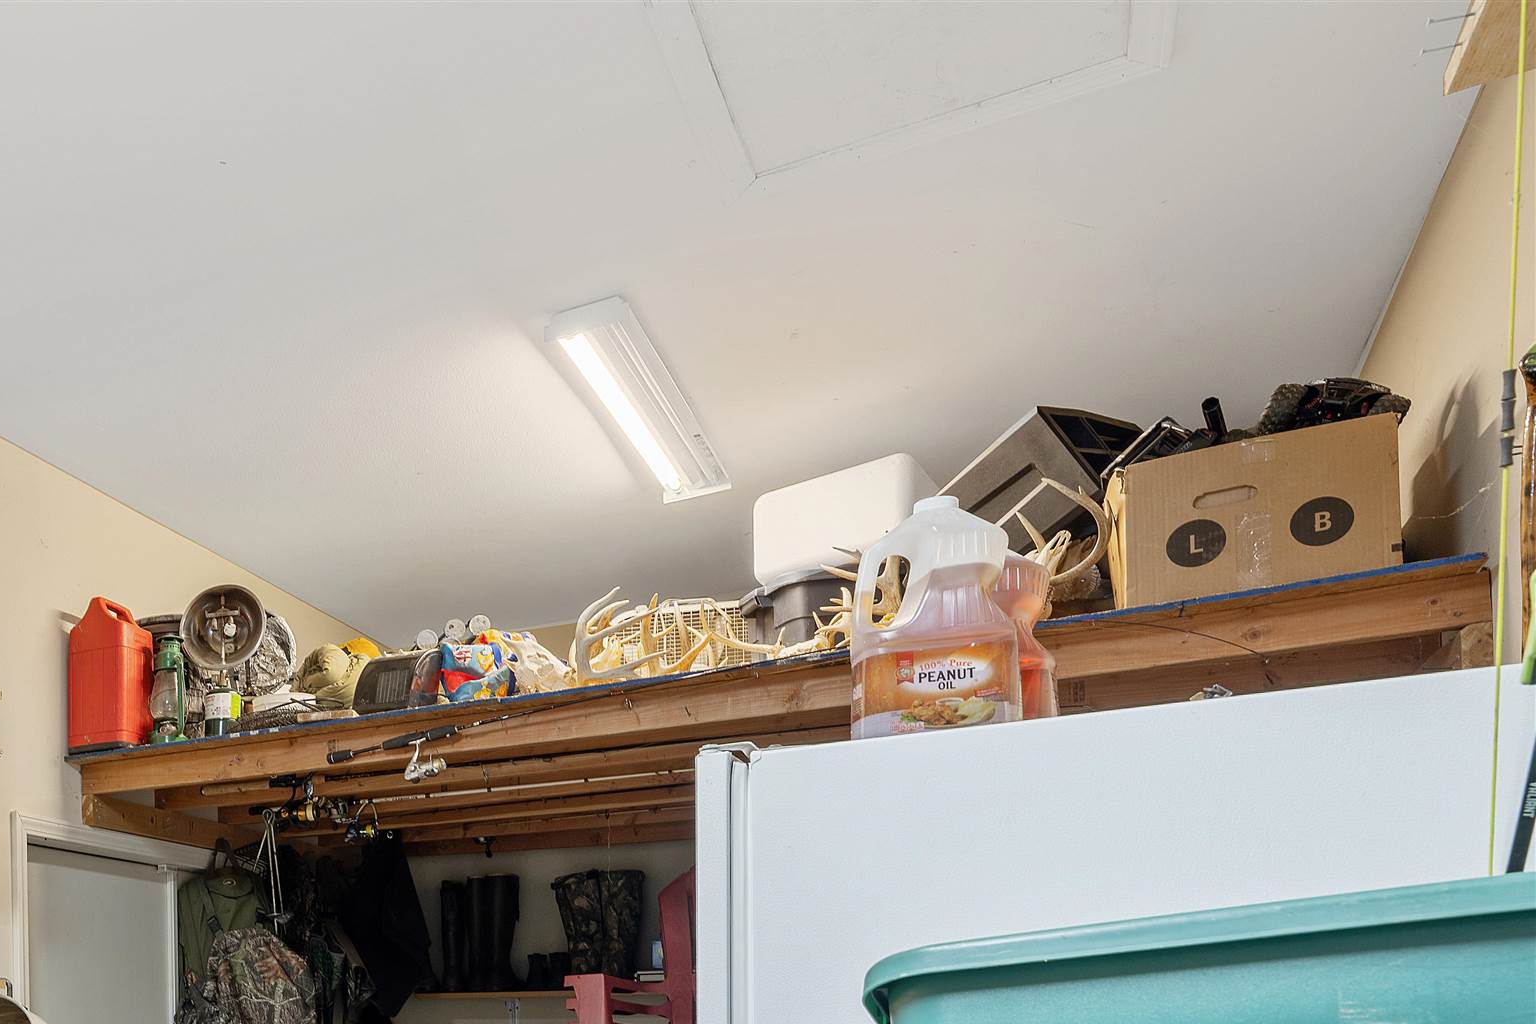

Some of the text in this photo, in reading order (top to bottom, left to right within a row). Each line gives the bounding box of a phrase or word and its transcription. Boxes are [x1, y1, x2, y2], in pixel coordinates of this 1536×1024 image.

[1314, 511, 1332, 533] B
[1189, 534, 1204, 555] L
[919, 659, 973, 671] 100% Pure
[918, 667, 976, 684] PEANUT
[938, 682, 956, 690] OIL
